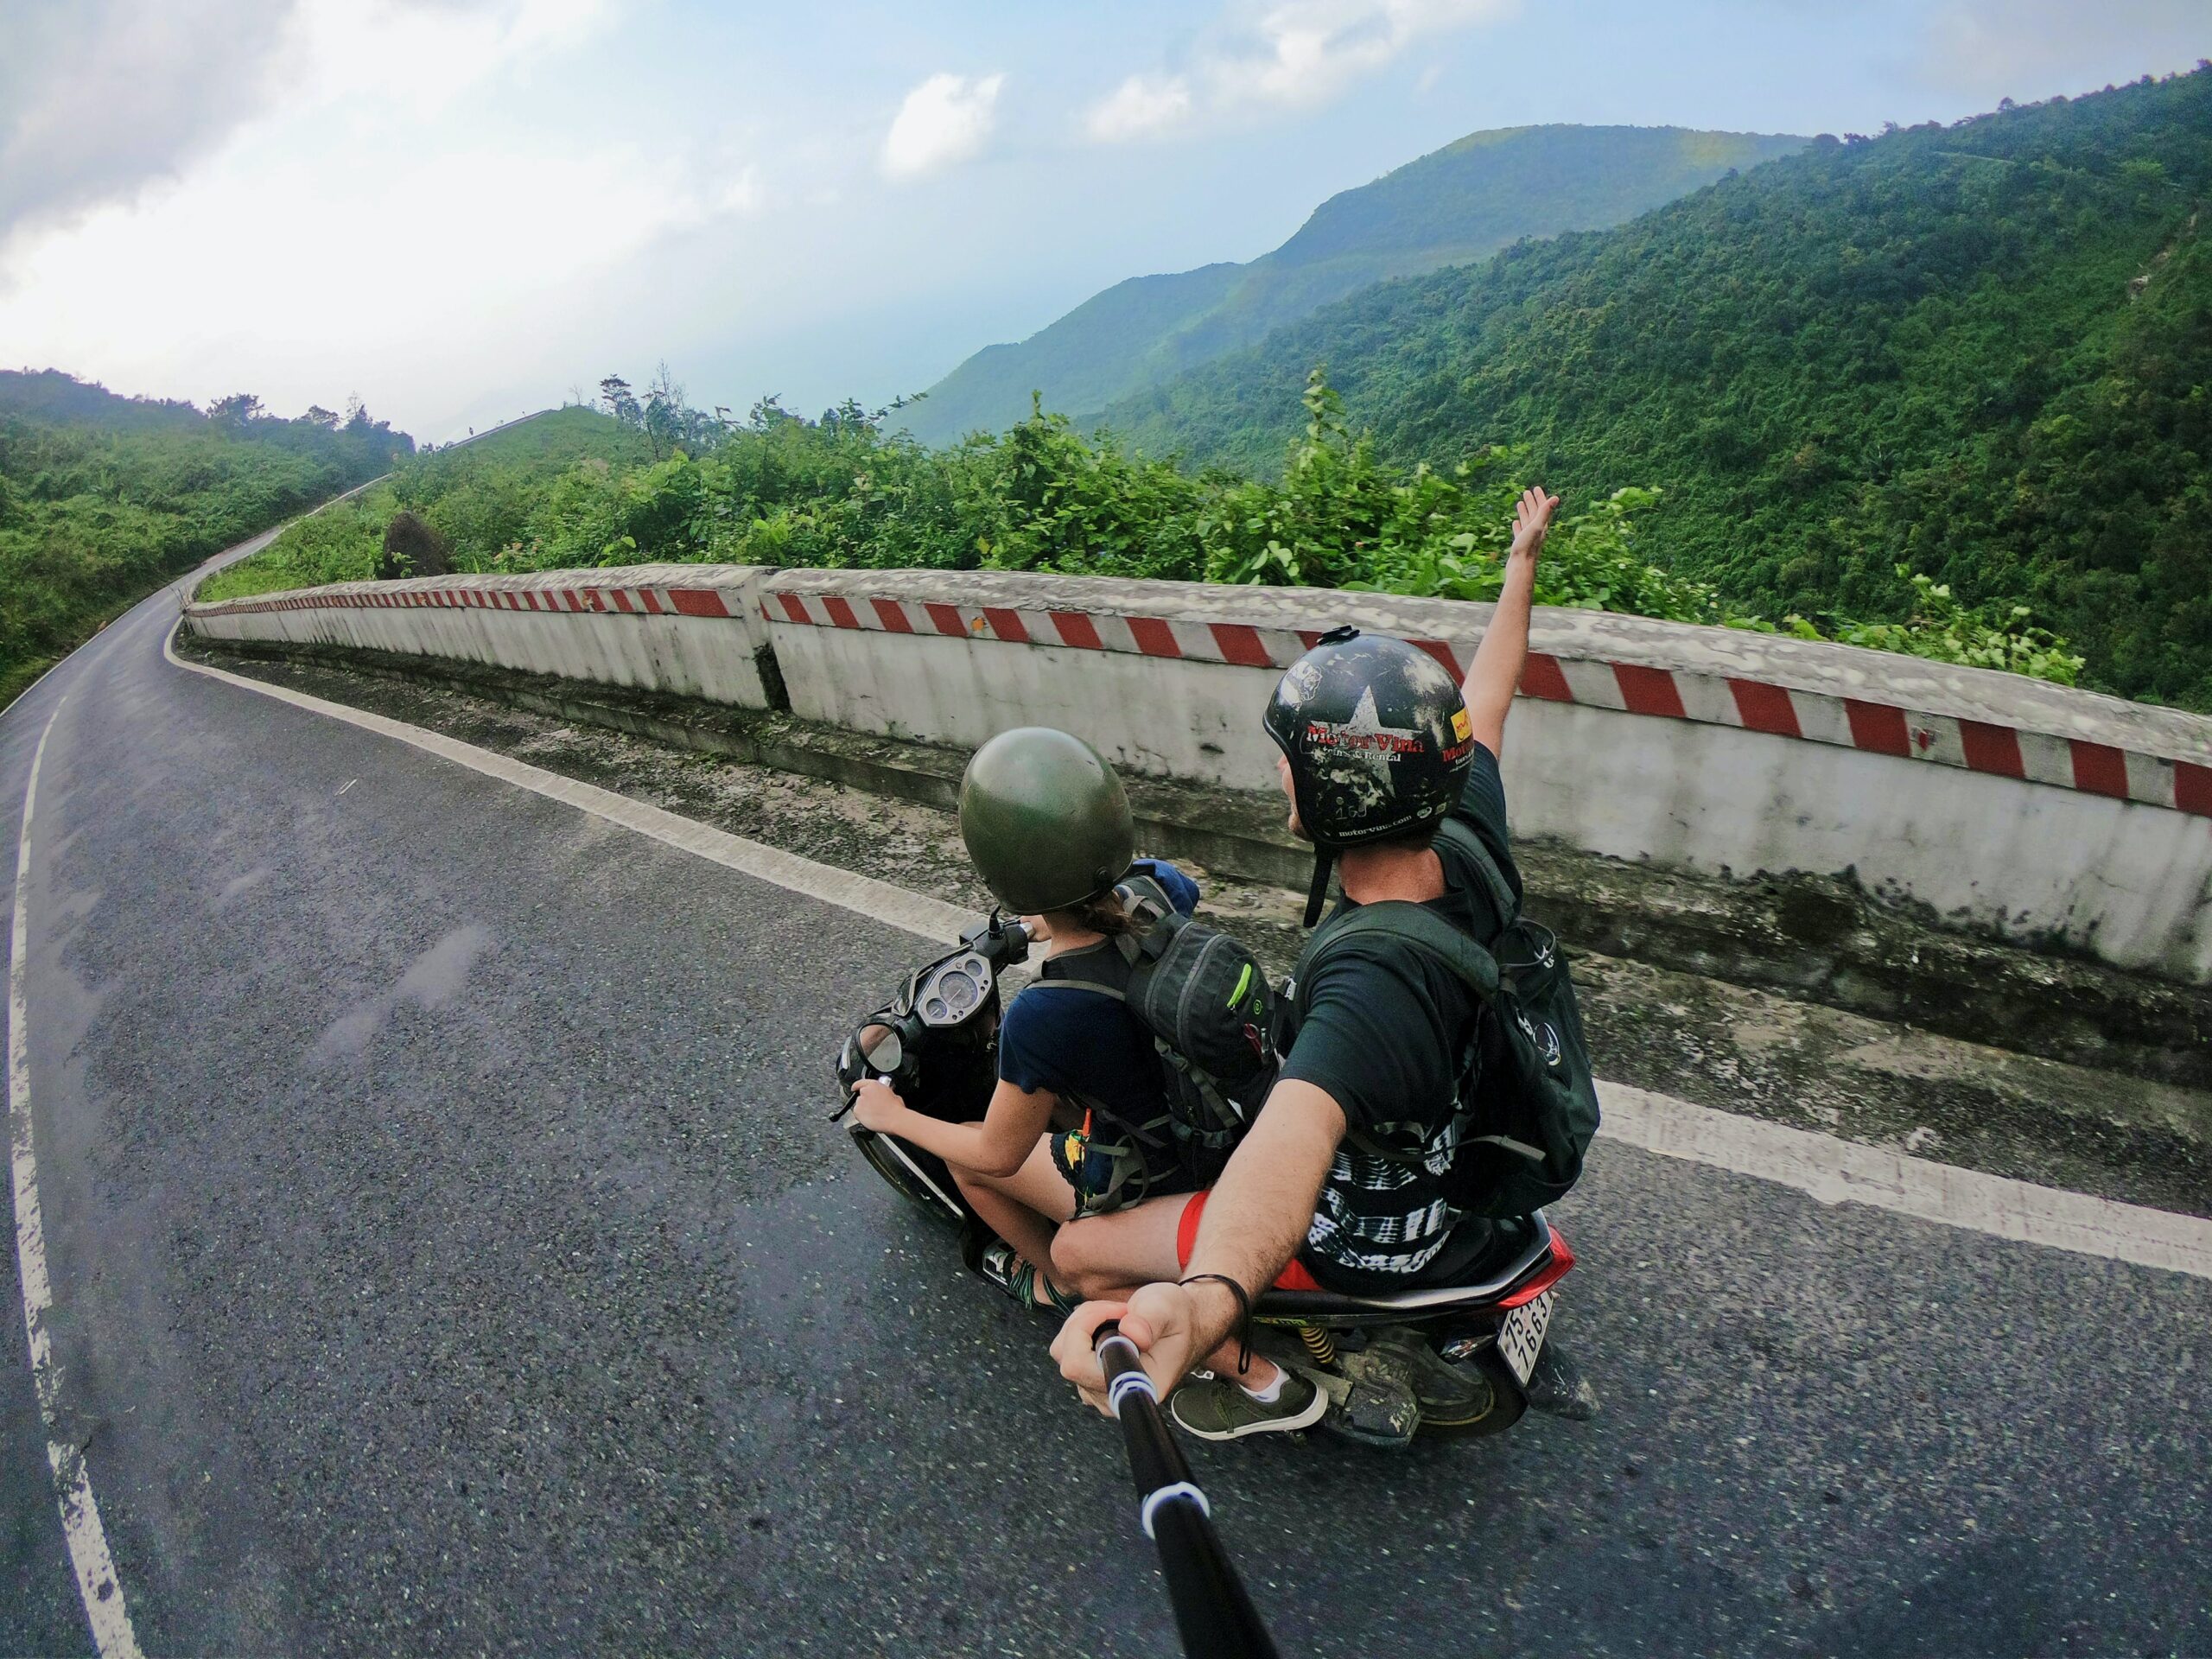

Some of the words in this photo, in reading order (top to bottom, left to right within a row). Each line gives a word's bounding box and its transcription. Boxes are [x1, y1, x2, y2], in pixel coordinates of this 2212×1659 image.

[1306, 724, 1376, 749] Motor
[1374, 733, 1424, 753] Vina
[1364, 751, 1402, 762] Rental
